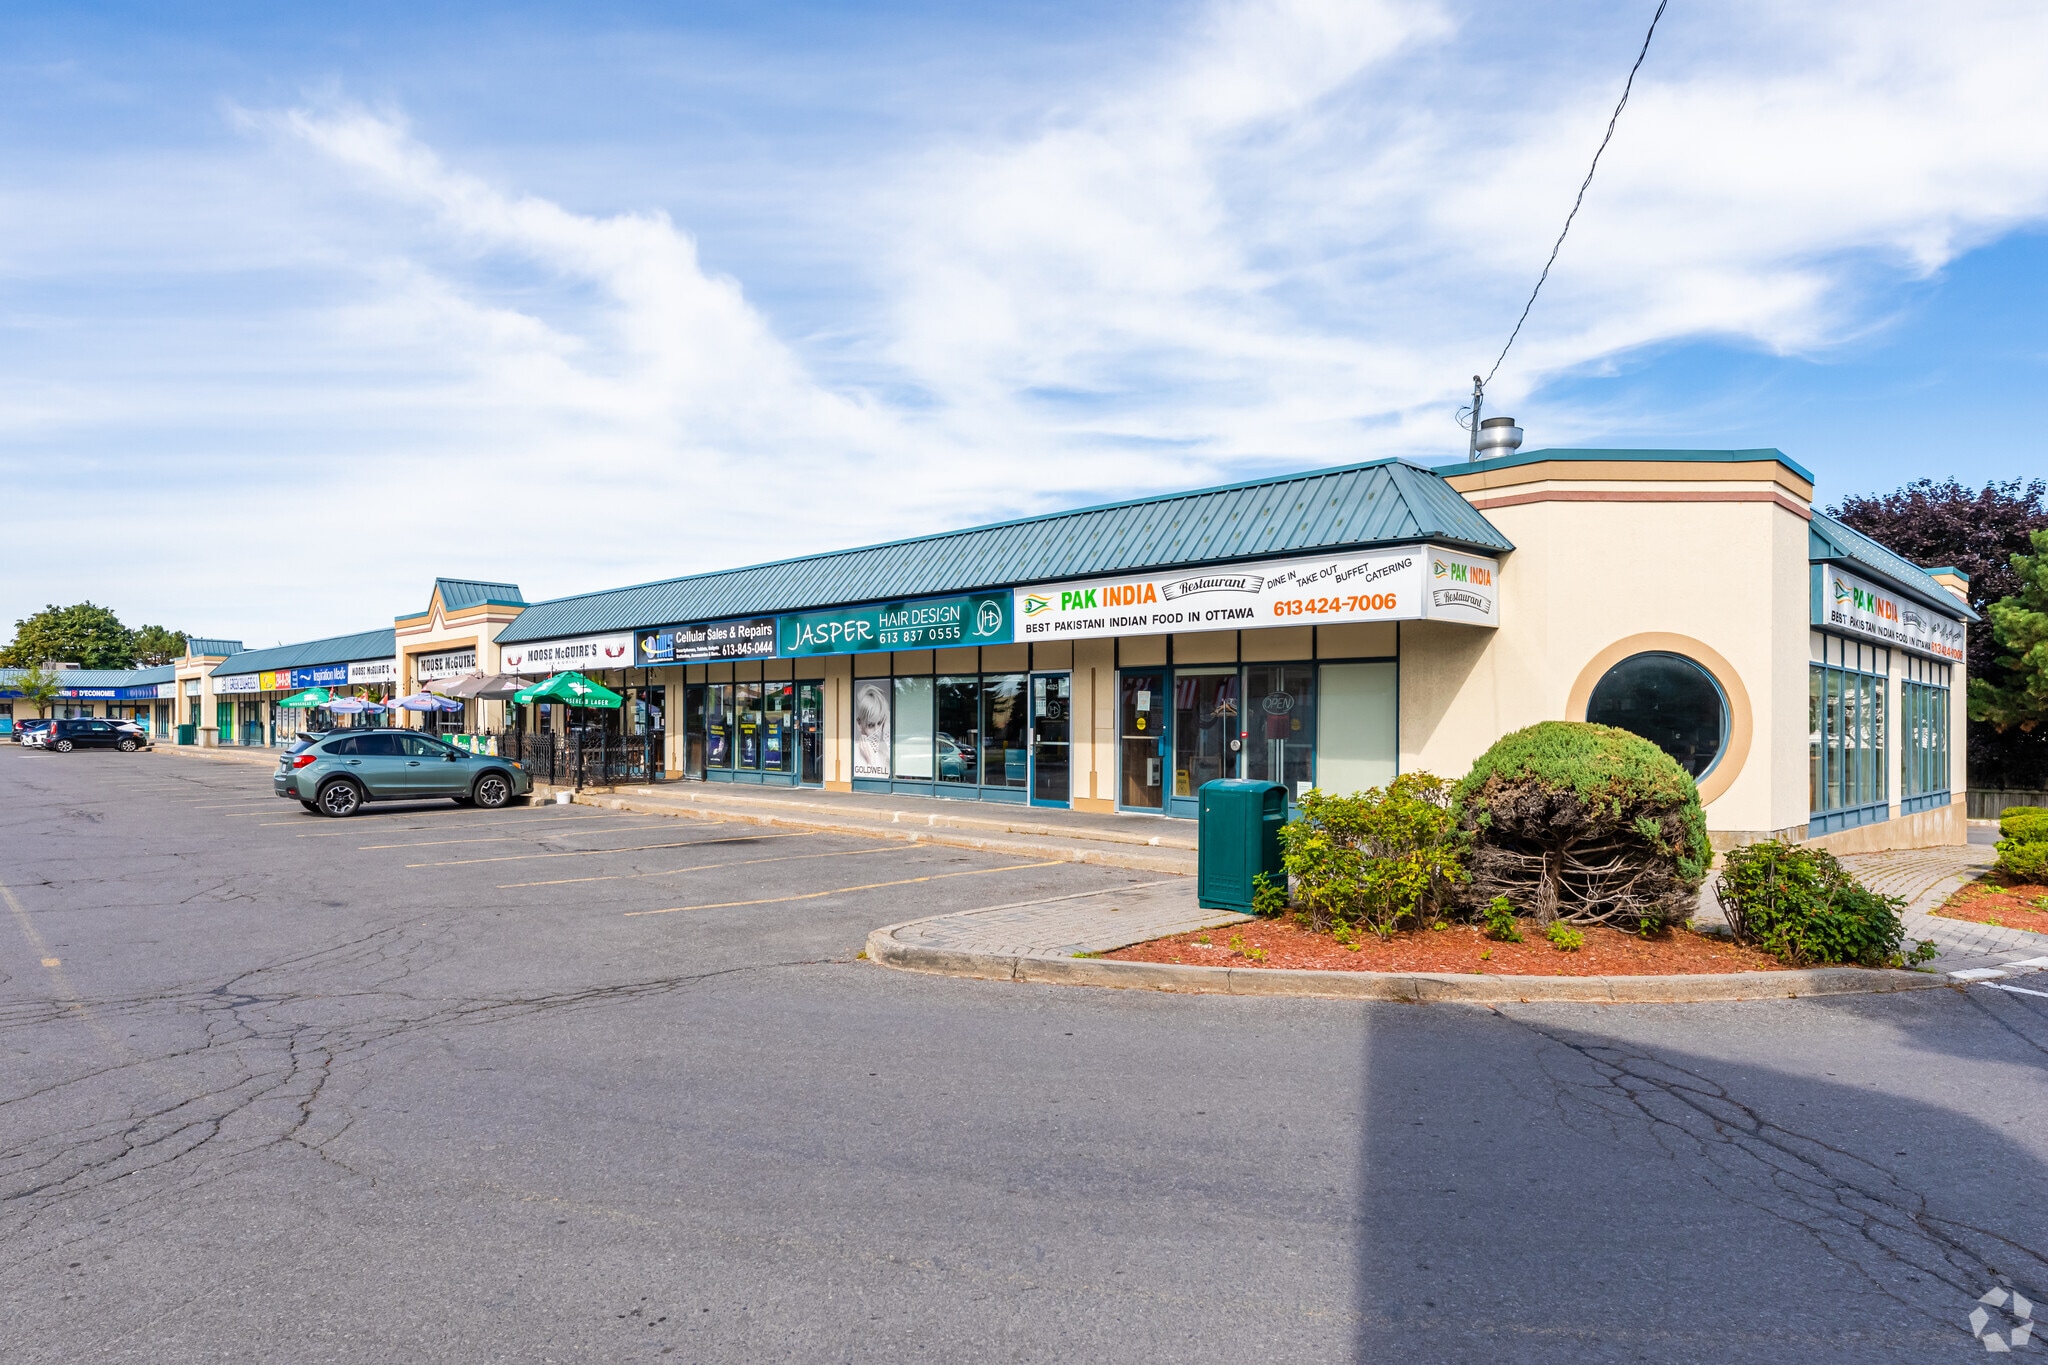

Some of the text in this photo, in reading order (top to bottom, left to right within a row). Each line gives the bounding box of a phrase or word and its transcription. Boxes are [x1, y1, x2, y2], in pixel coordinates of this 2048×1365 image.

[1267, 570, 1297, 589] DINE IN
[1296, 564, 1338, 588] TAKE OUT
[1335, 563, 1369, 583] BUFFET
[1365, 558, 1412, 583] CATERING
[1451, 562, 1492, 587] PAK INDIA
[1179, 576, 1248, 594] Restaurant
[1061, 583, 1157, 611] PAK INDIA
[1274, 592, 1396, 617] 613 424-7006
[1444, 591, 1482, 608] Restaurant
[1853, 587, 1898, 623] PAK INDIA
[879, 606, 960, 627] HAIR DESIGN
[1026, 608, 1254, 634] BEST PAKISTANI INDIAN FOOD IN OTTAWA
[1832, 610, 1848, 624] BEST
[676, 624, 772, 644] Cellular Sales & Repairs
[788, 620, 874, 651] JASPER
[880, 626, 961, 644] 613 837 0555
[528, 644, 597, 662] MOOSE McGUIRE'S
[722, 640, 773, 656] 613-845-0444
[421, 658, 444, 672] MOOSE
[1264, 698, 1292, 709] OPEN
[854, 765, 889, 775] GOLDWELL
